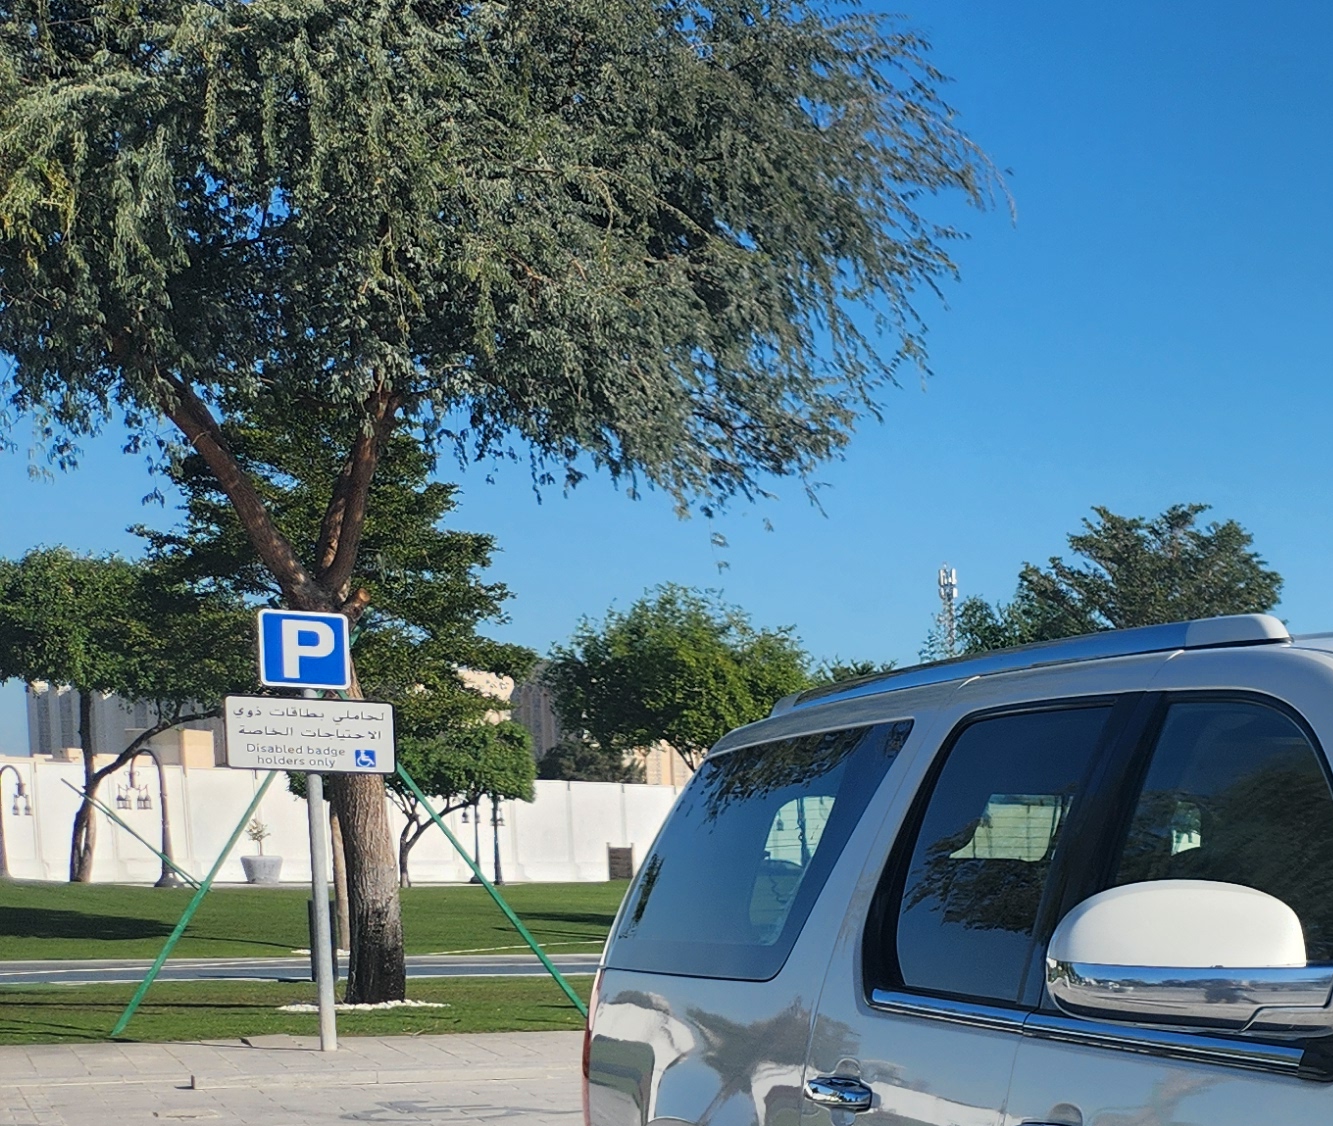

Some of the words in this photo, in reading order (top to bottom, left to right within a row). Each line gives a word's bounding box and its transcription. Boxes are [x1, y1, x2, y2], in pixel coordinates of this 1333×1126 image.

[281, 618, 335, 679] P
[233, 706, 262, 719] ذوي
[269, 707, 325, 721] بطاقات
[332, 711, 385, 725] لحاملي
[238, 725, 293, 737] الخاصة
[246, 743, 303, 755] Disabled
[307, 745, 346, 758] badge
[257, 755, 305, 766] holders
[309, 757, 336, 769] only
